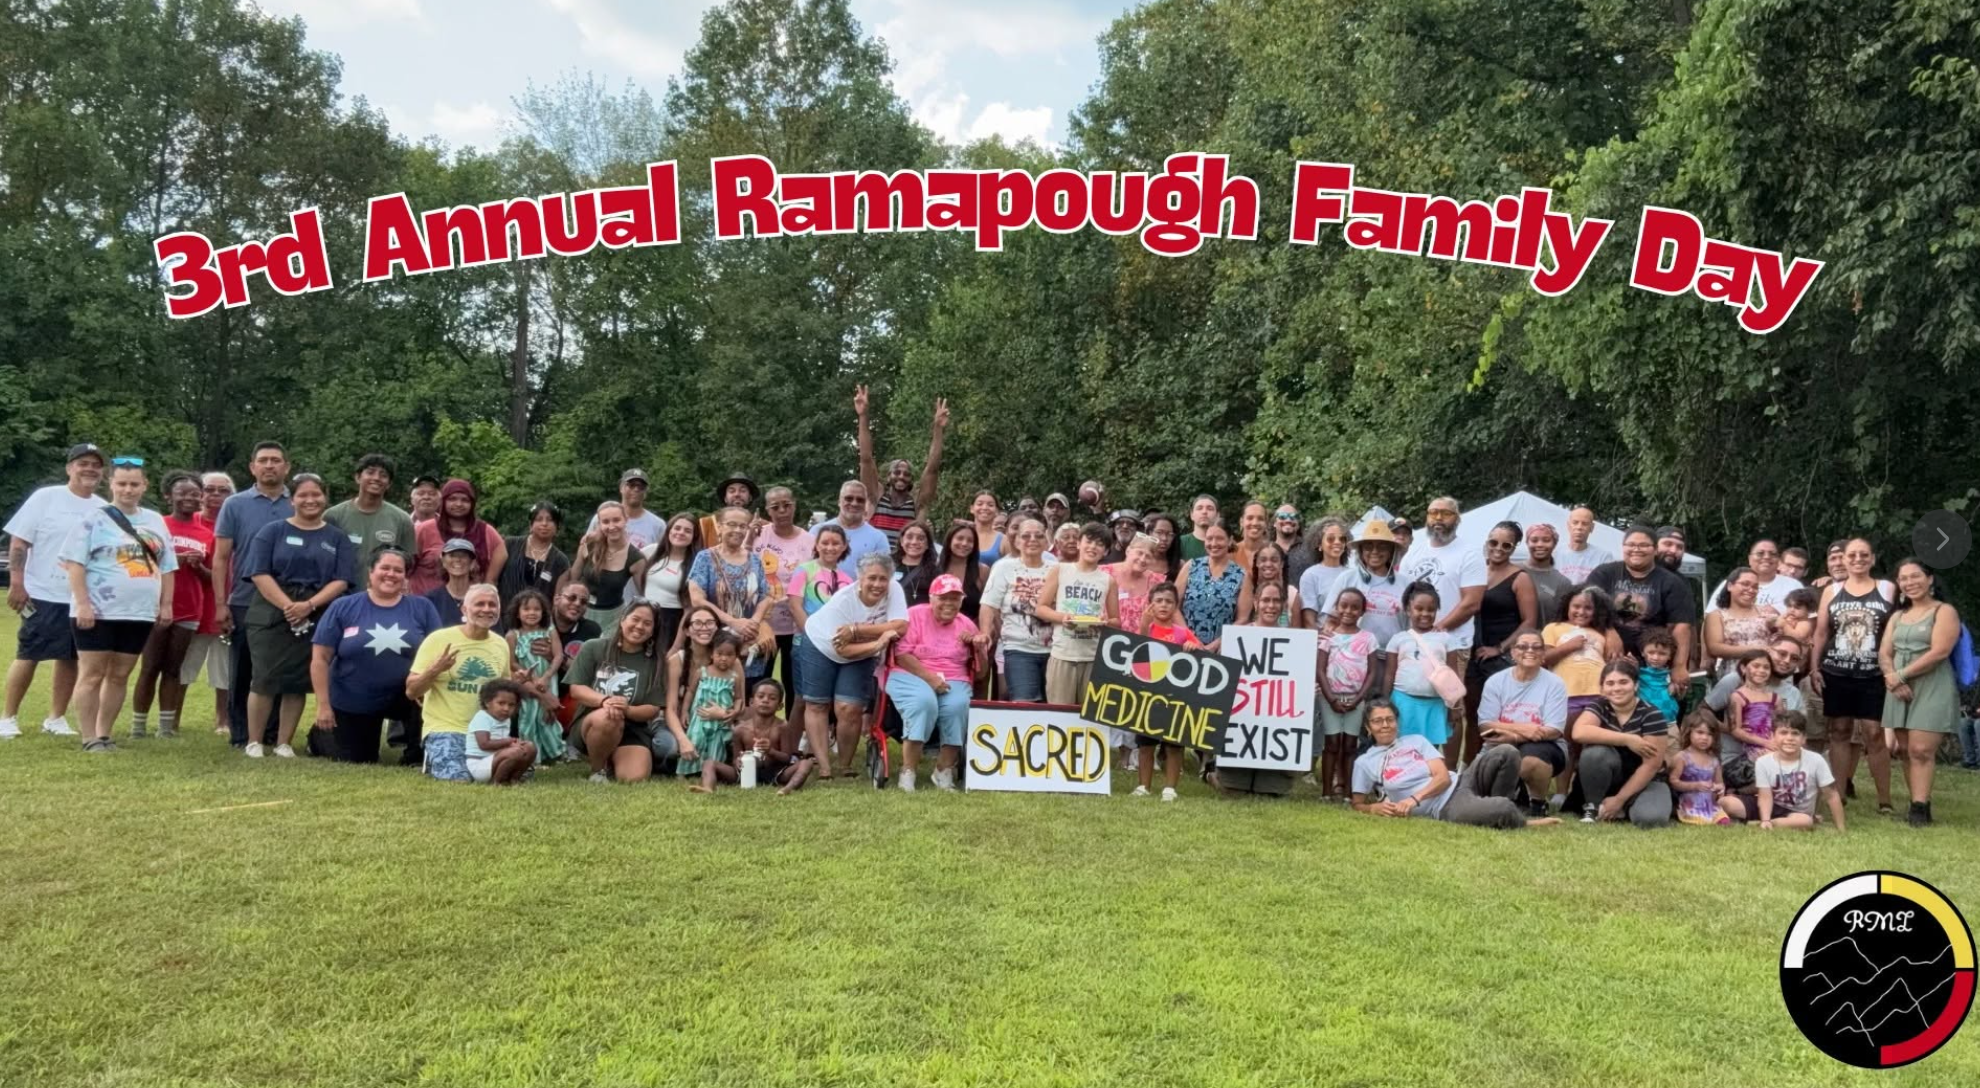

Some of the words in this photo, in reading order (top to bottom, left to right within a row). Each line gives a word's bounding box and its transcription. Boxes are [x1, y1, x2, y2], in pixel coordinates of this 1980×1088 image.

[1101, 634, 1229, 695] GOOD
[1237, 636, 1290, 676] WE
[1081, 681, 1223, 750] MEDICINE
[1230, 679, 1305, 717] STILL
[969, 723, 1106, 783] SACRED
[1220, 723, 1311, 764] EXIST
